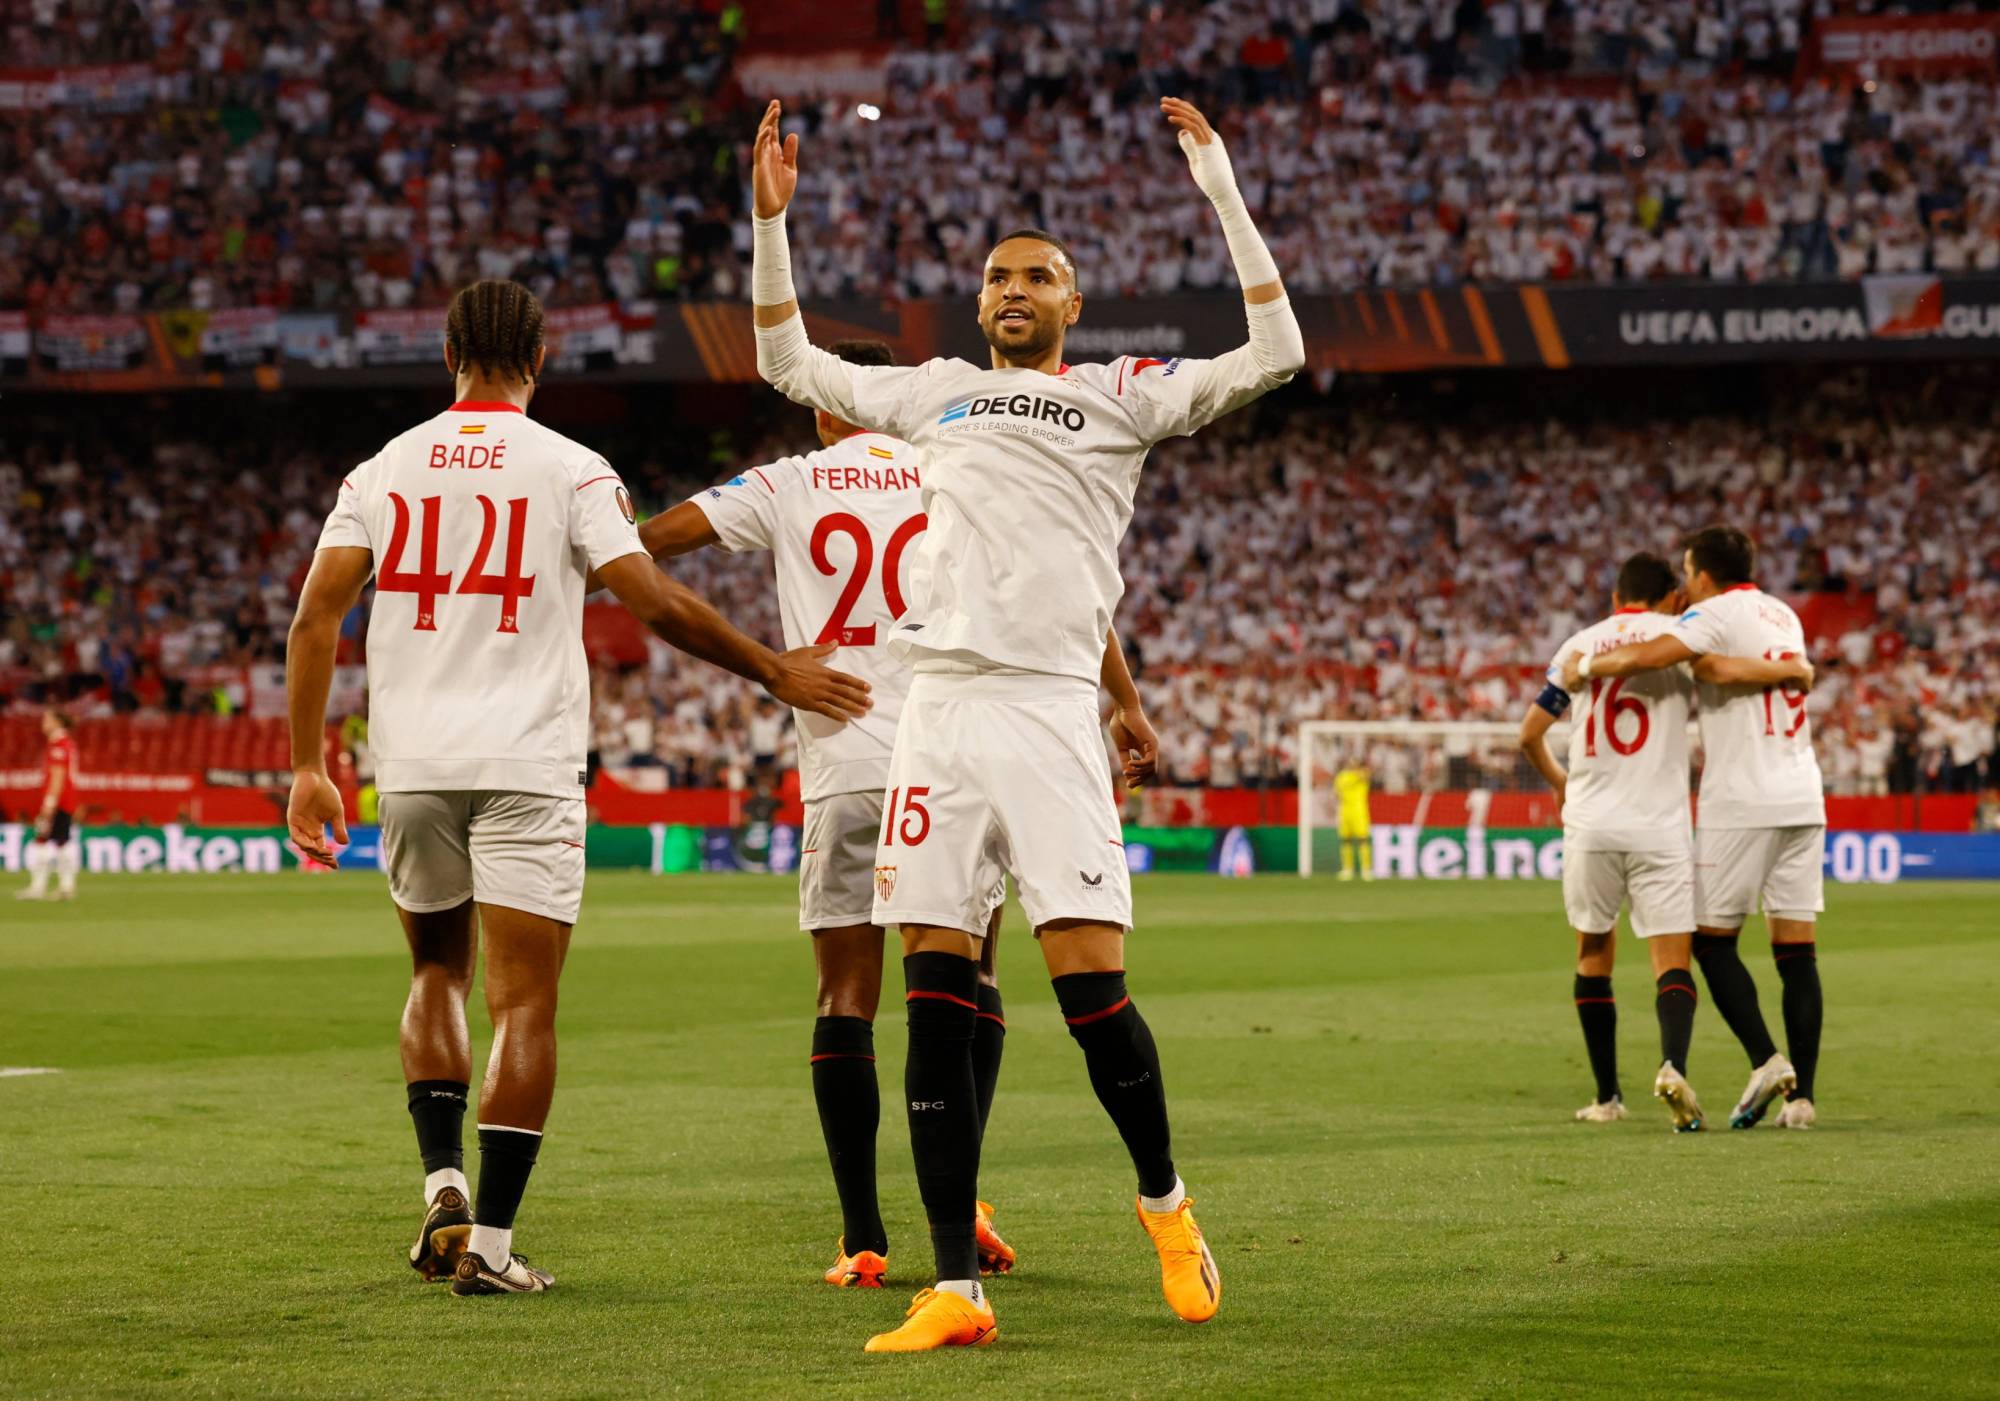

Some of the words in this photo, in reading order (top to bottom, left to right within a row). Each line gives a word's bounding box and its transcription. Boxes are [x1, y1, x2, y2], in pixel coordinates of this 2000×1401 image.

[1619, 310, 1717, 344] UEFA
[1723, 307, 1864, 341] EUROPA
[969, 394, 1086, 432] DEGIRO
[429, 438, 507, 469] BADÉ
[981, 422, 1029, 438] LEADING
[1031, 429, 1076, 448] BROKER
[813, 466, 921, 491] FERNAN
[376, 491, 537, 634] 44
[1585, 676, 1650, 757] 16
[883, 785, 931, 847] 15
[911, 1101, 945, 1111] SFC
